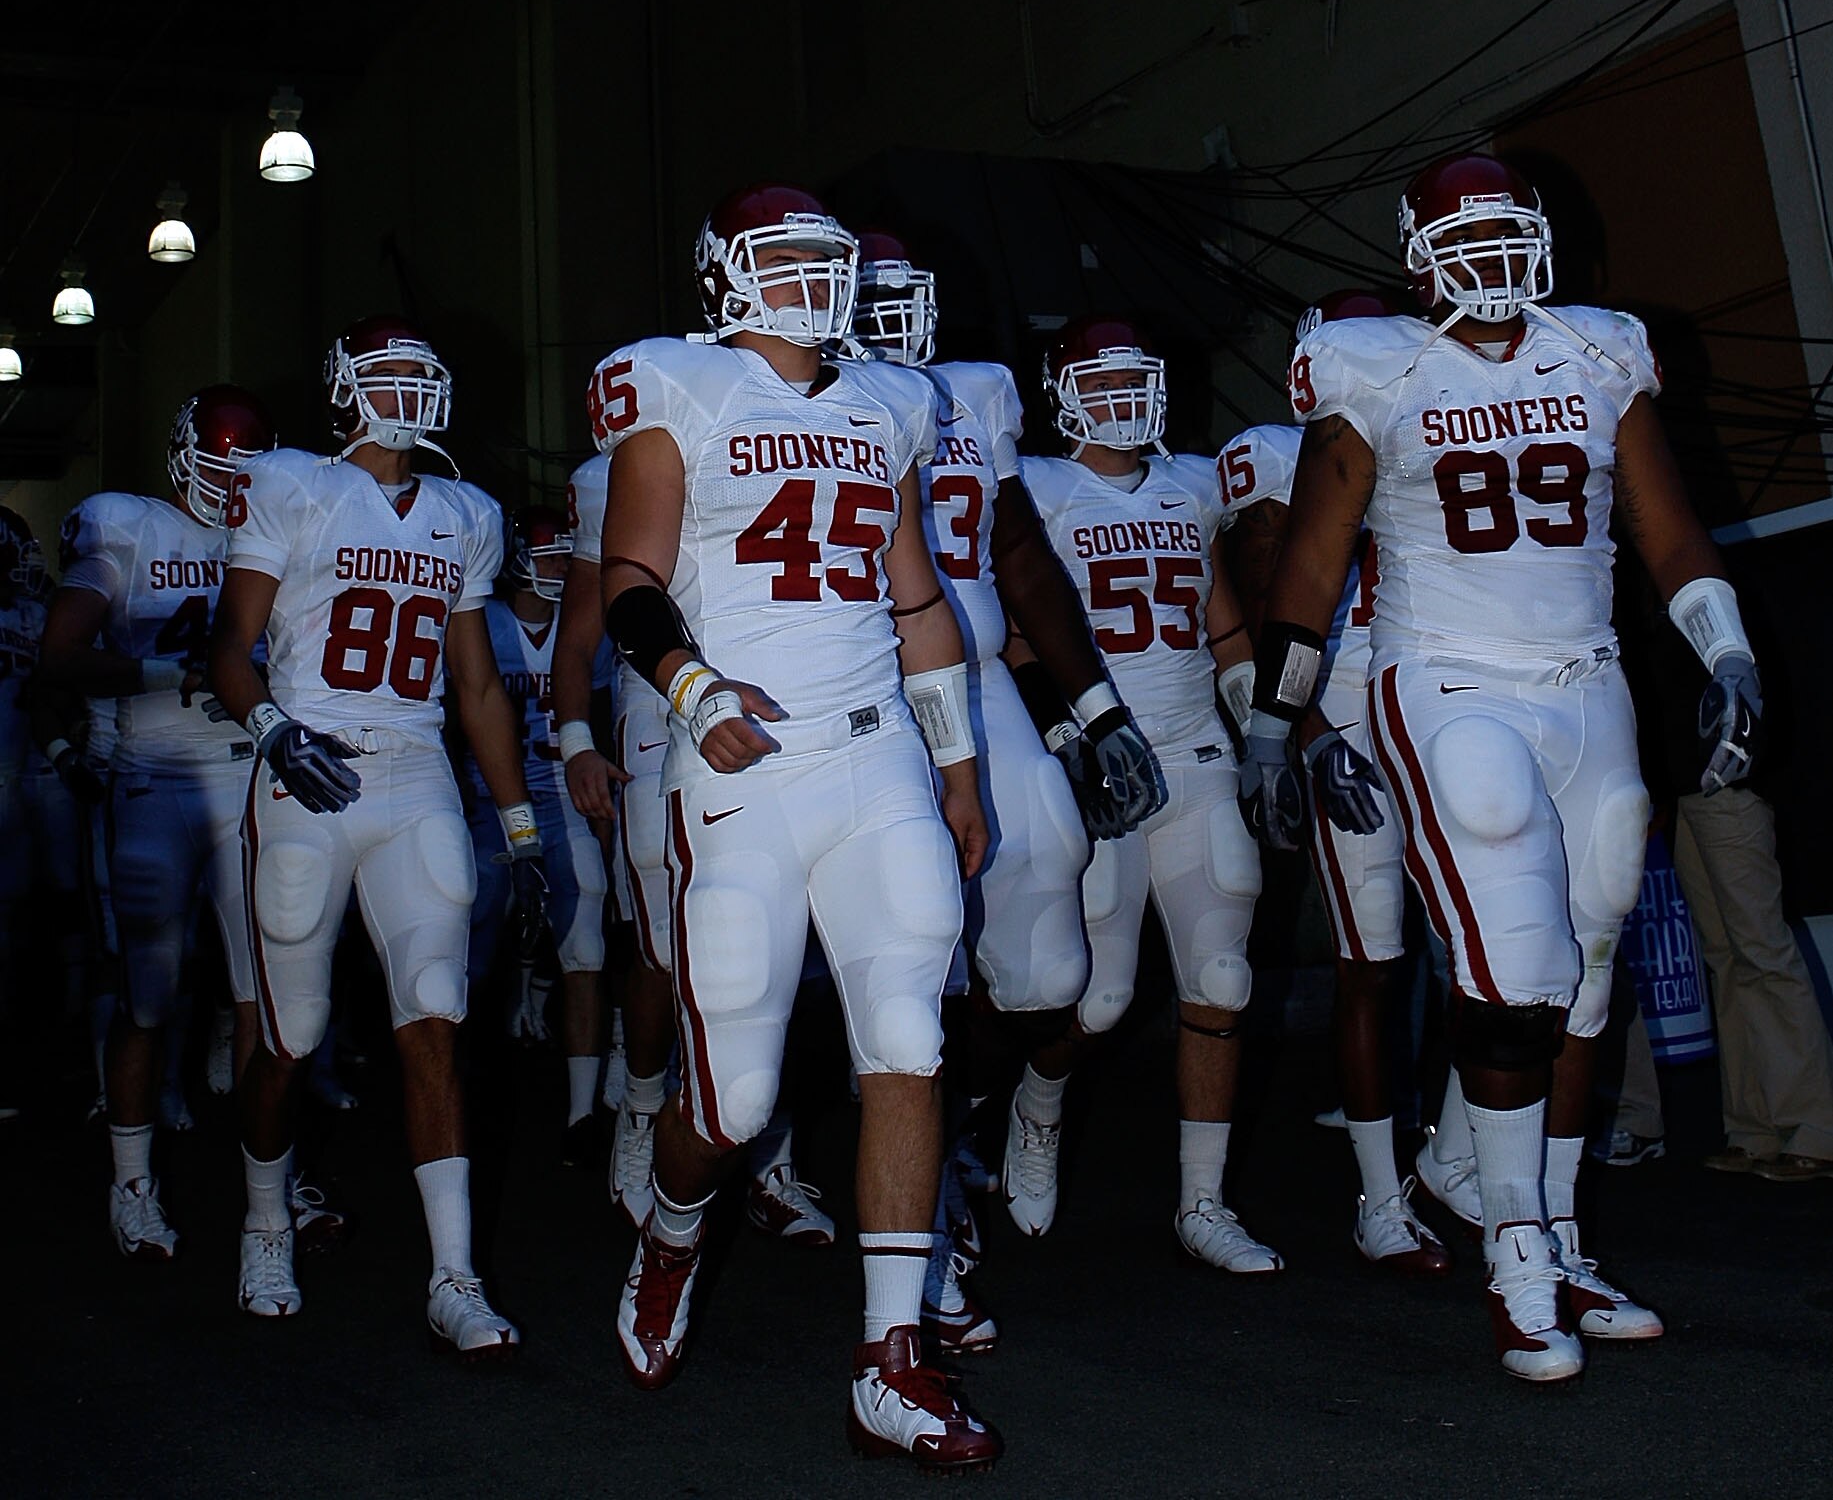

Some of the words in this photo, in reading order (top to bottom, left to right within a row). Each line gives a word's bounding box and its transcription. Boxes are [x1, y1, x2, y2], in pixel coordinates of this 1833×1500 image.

[1288, 354, 1316, 415] 9
[1421, 394, 1589, 446] SOONERS
[729, 433, 888, 483] SOONERS
[1433, 442, 1590, 554] 89
[735, 478, 896, 602] 45
[1073, 521, 1201, 559] SOONERS
[335, 547, 461, 594] SOONERS
[1087, 557, 1204, 655] 55
[320, 587, 447, 701] 86
[856, 712, 873, 724] 44
[1636, 867, 1686, 921] ATE
